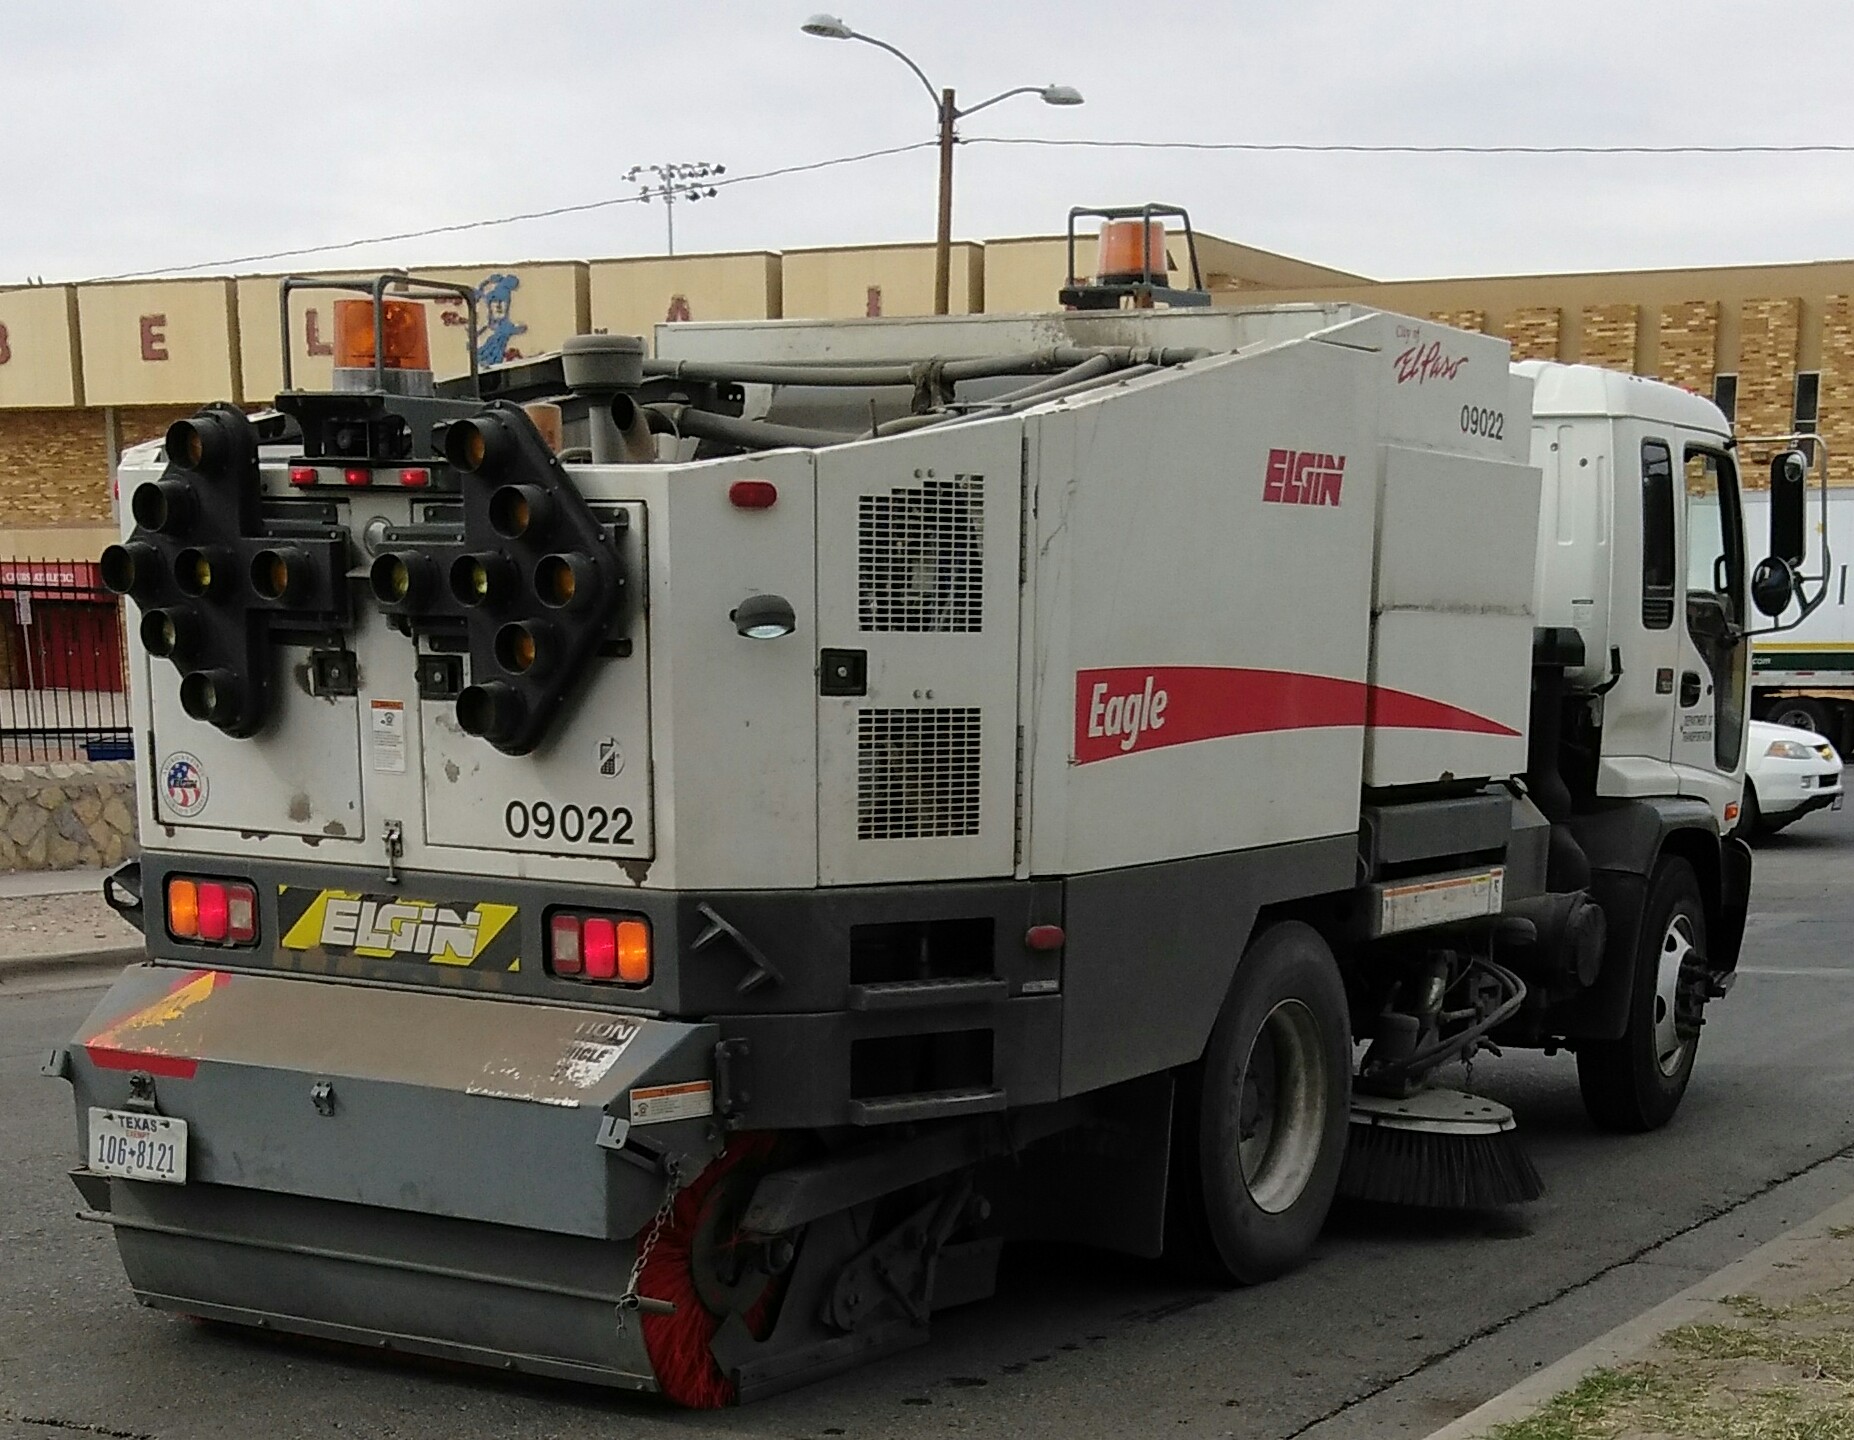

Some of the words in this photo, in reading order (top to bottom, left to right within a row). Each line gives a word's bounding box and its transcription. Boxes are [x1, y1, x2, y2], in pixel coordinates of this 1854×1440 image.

[1394, 344, 1426, 384] El
[1419, 341, 1469, 385] Paso
[1460, 404, 1504, 440] 09022
[1262, 448, 1346, 507] ELGIN
[1088, 676, 1168, 751] Eagle
[505, 800, 635, 845] 09022
[319, 897, 482, 959] ELGIN
[118, 1114, 158, 1133] TEXAS
